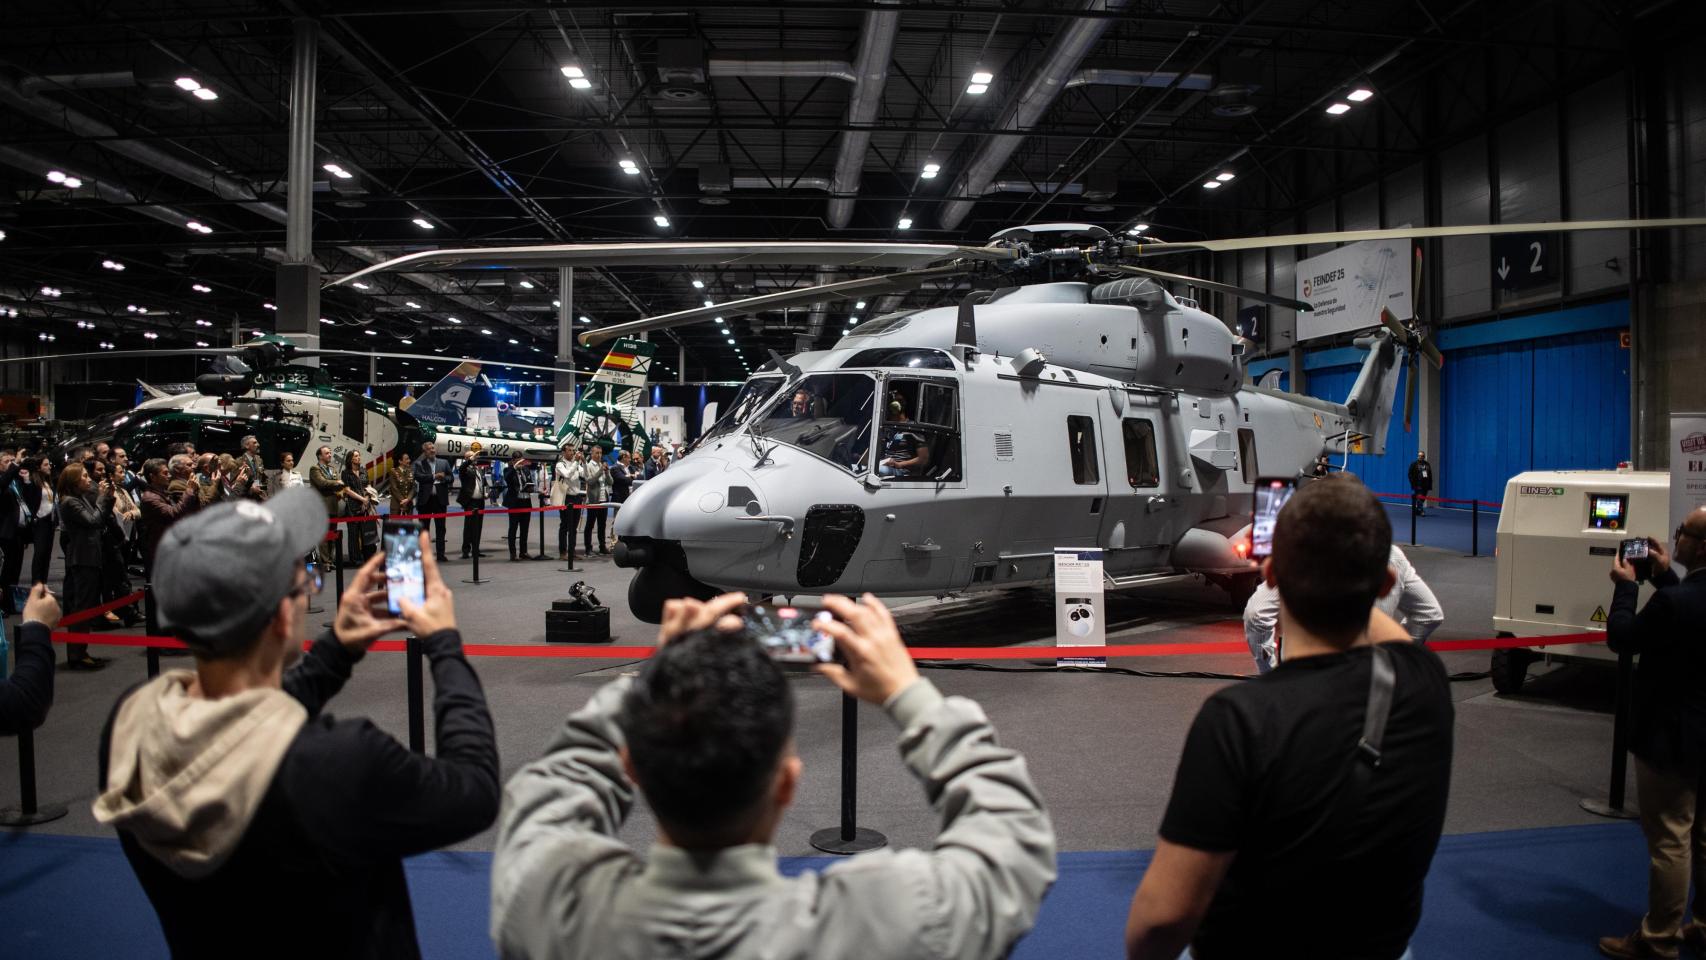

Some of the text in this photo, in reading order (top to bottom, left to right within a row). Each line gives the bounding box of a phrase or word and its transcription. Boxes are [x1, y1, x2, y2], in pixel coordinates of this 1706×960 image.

[1530, 241, 1543, 273] 2
[1313, 268, 1345, 287] FEINDEF 25
[1251, 316, 1258, 337] 2
[288, 373, 309, 384] 322
[447, 439, 510, 457] 09 322
